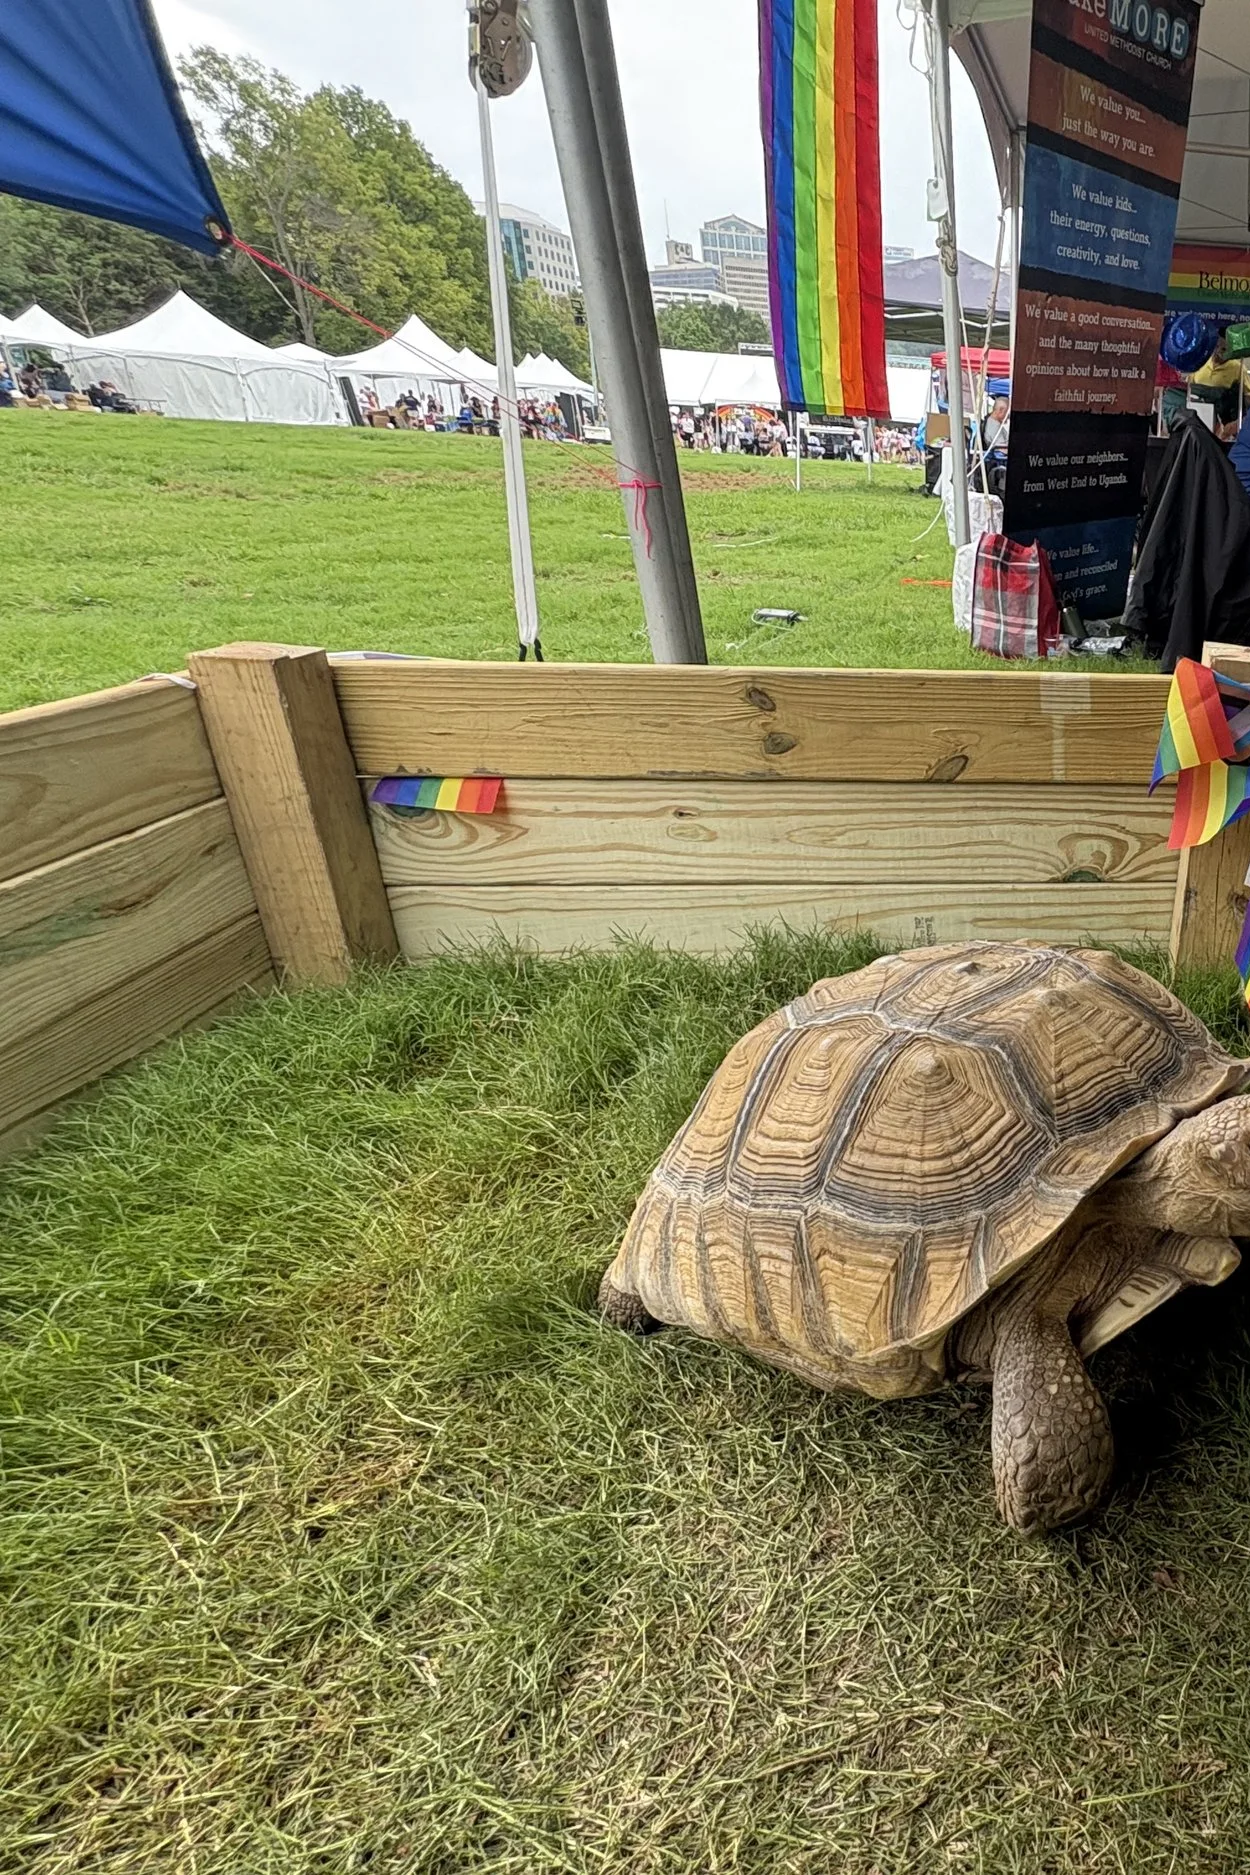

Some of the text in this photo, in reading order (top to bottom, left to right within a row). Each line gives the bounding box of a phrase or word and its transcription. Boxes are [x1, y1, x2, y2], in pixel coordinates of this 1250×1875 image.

[1084, 23, 1172, 70] UNITED METHODIST CHURCH
[1080, 85, 1096, 105] We
[1098, 94, 1123, 115] value
[1062, 112, 1156, 158] just the way you are.
[1072, 183, 1087, 200] We
[1089, 190, 1113, 208] value
[1050, 210, 1152, 248] their energy, questions,
[1056, 244, 1141, 270] creativity, and love.
[1025, 303, 1041, 319] We
[1044, 306, 1069, 322] value
[1070, 312, 1076, 323] a
[1078, 312, 1100, 327] good
[1218, 311, 1239, 322] here,
[1240, 314, 1250, 322] no
[1039, 335, 1142, 357] and the many thoughtful
[1025, 362, 1146, 379] opinions about how to walk a
[1054, 388, 1118, 405] faithful journey.
[1028, 454, 1044, 468] We
[1046, 453, 1069, 466] value
[1070, 454, 1085, 465] our
[1023, 480, 1045, 493] from
[1047, 477, 1069, 490] West
[1071, 475, 1088, 489] End
[1089, 475, 1097, 487] to
[1060, 547, 1081, 558] value
[1064, 567, 1080, 580] and
[1080, 559, 1119, 576] reconciled
[1085, 584, 1108, 598] grace.
